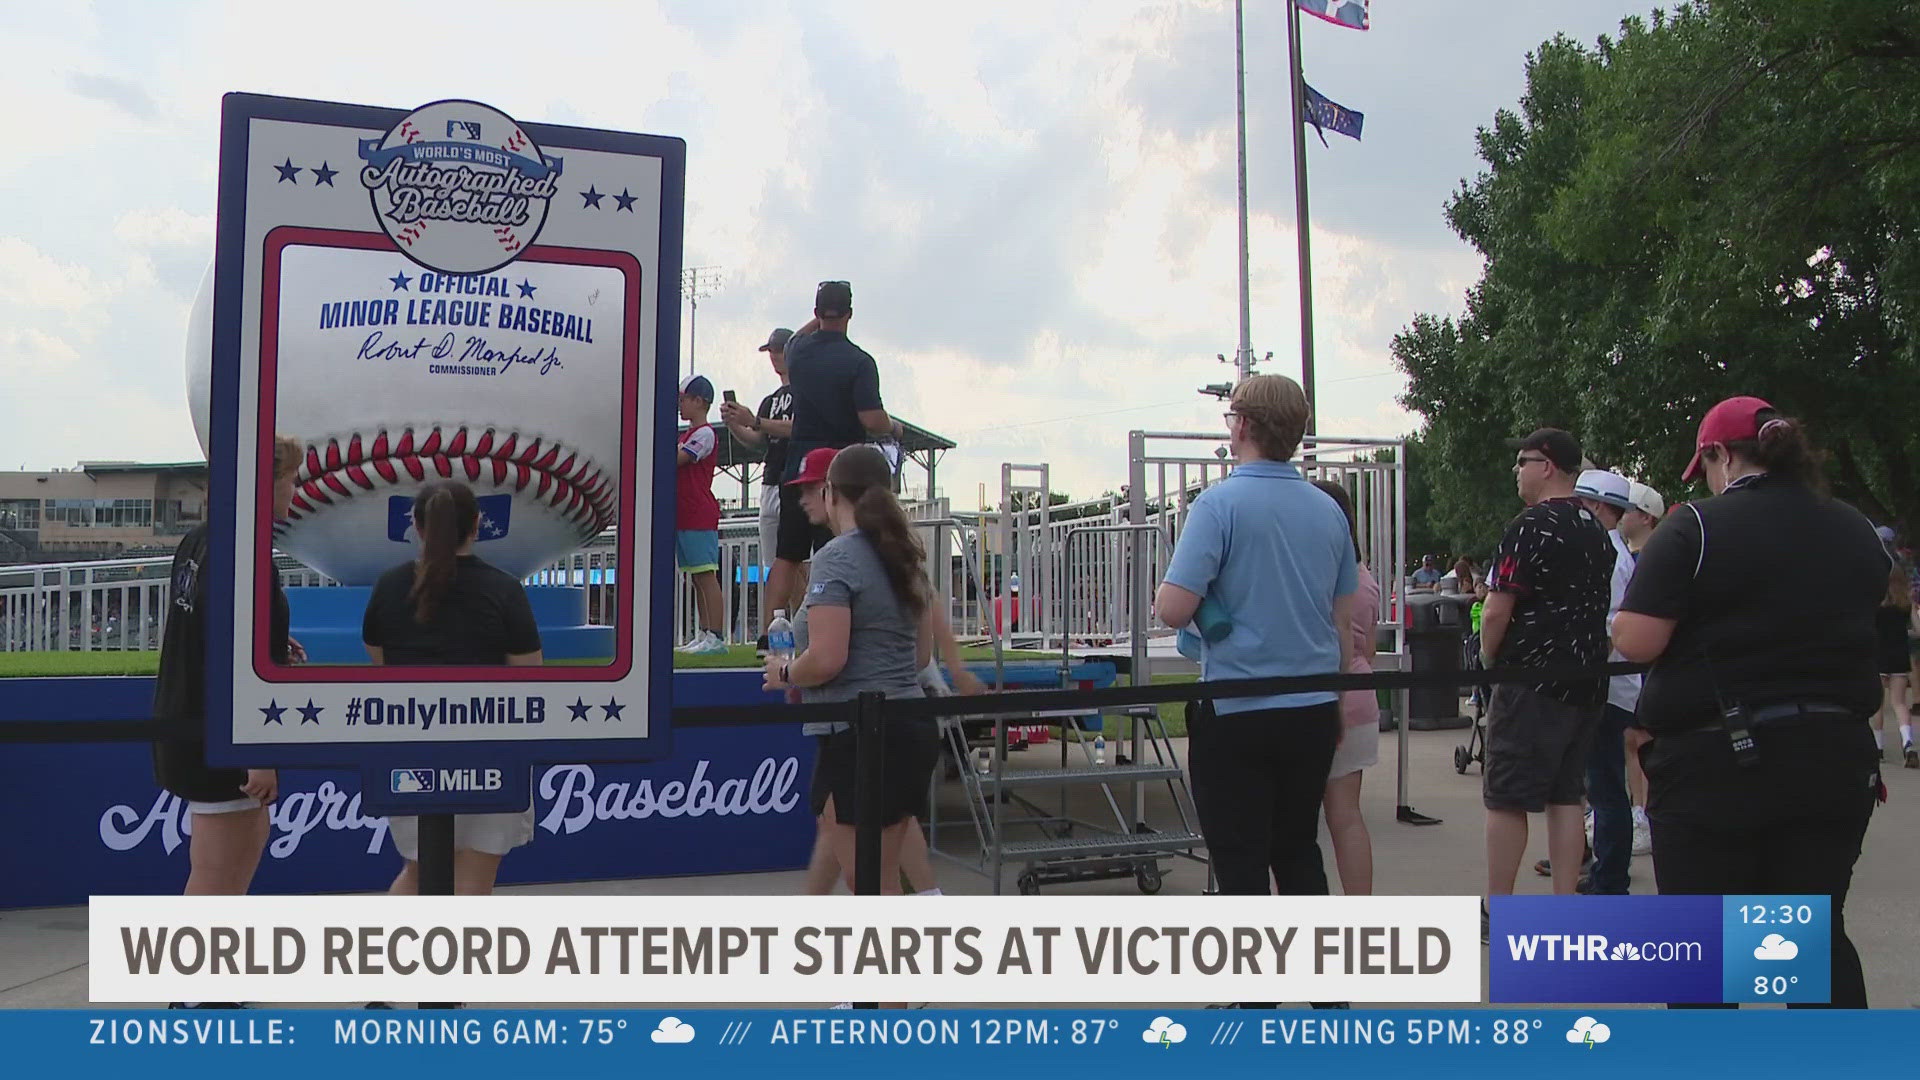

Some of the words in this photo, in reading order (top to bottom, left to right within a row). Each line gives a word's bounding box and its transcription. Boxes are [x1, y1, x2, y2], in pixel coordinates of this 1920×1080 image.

[413, 146, 472, 160] WORLD'S
[474, 150, 512, 168] MOST
[361, 157, 558, 201] Autographed
[386, 188, 529, 225] Baseball
[419, 273, 510, 298] OFFICIAL
[320, 299, 399, 329] MINOR
[406, 299, 492, 328] LEAGUE
[499, 304, 593, 343] BASEBALL
[429, 364, 497, 376] COMMISSIONER
[345, 697, 545, 730] #OnlyInMiLB
[439, 769, 502, 791] MiLB
[539, 757, 800, 835] Baseball
